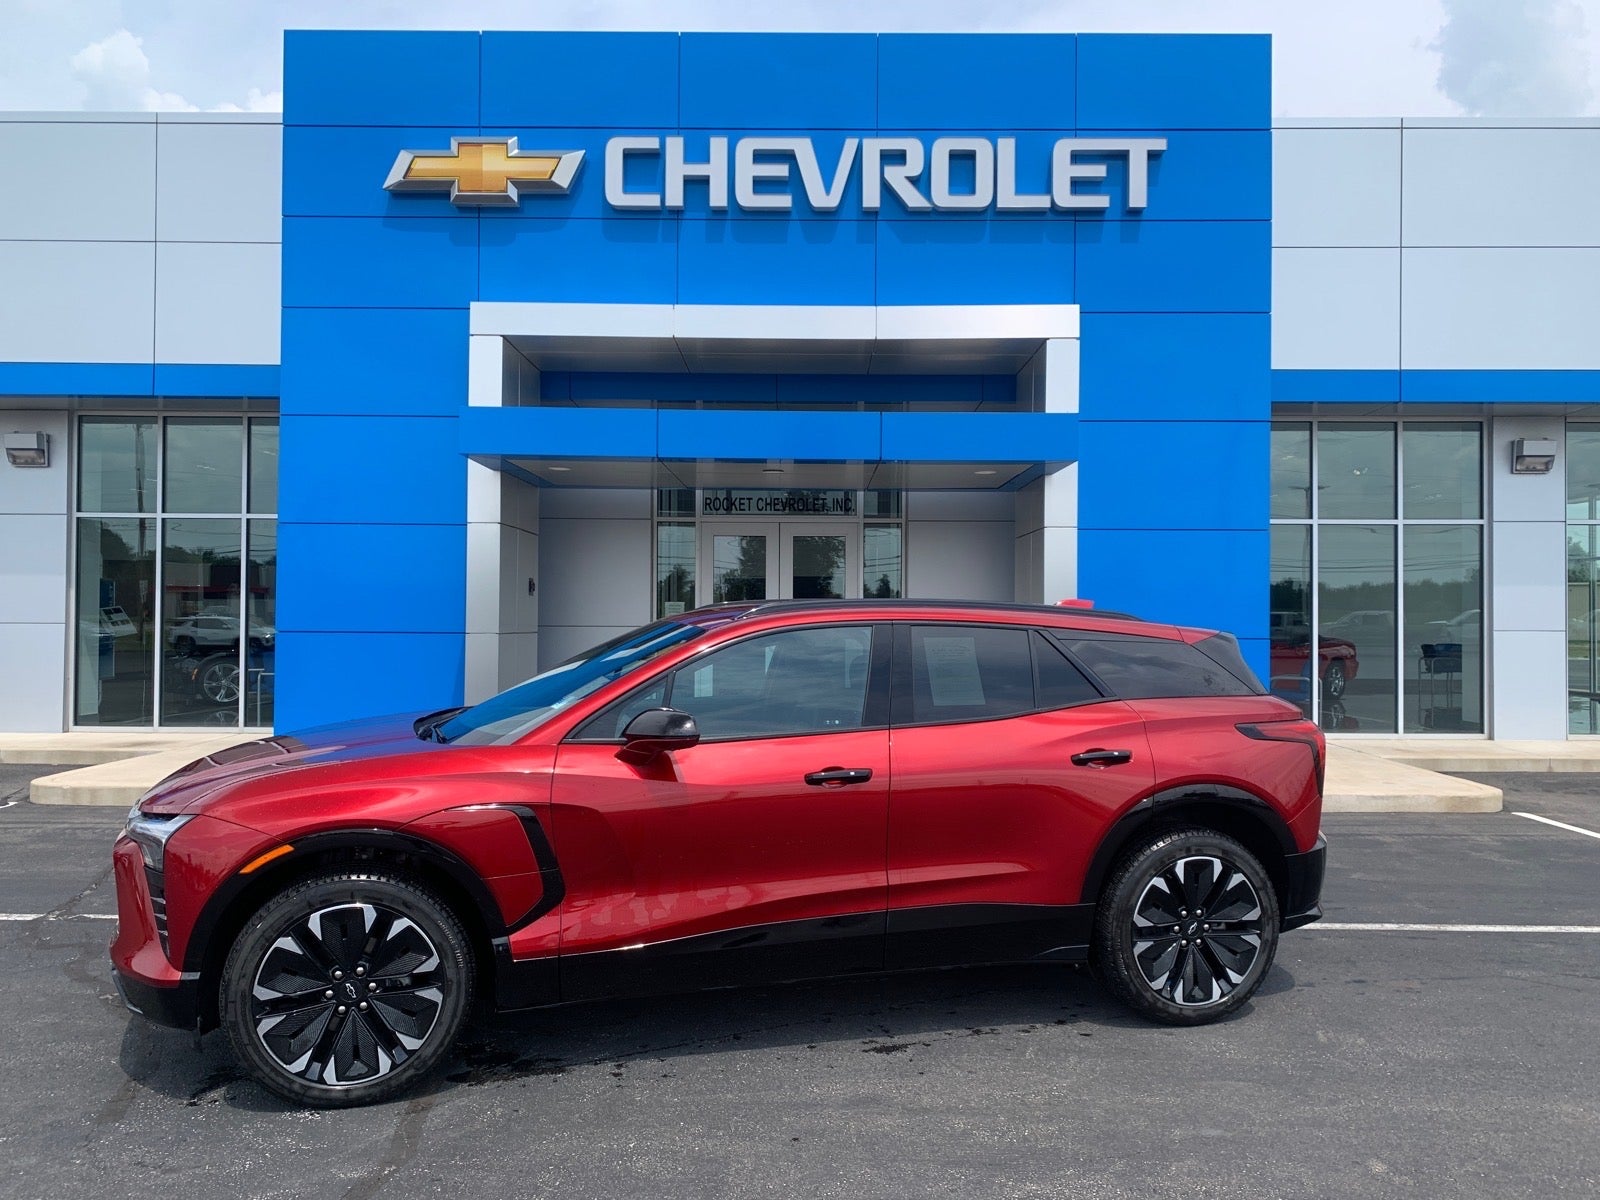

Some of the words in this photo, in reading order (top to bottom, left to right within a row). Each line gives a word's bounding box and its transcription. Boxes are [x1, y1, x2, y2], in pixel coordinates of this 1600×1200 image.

[604, 136, 1168, 212] CHEVROLET
[704, 497, 754, 512] ROCKET
[832, 498, 855, 512] INC.
